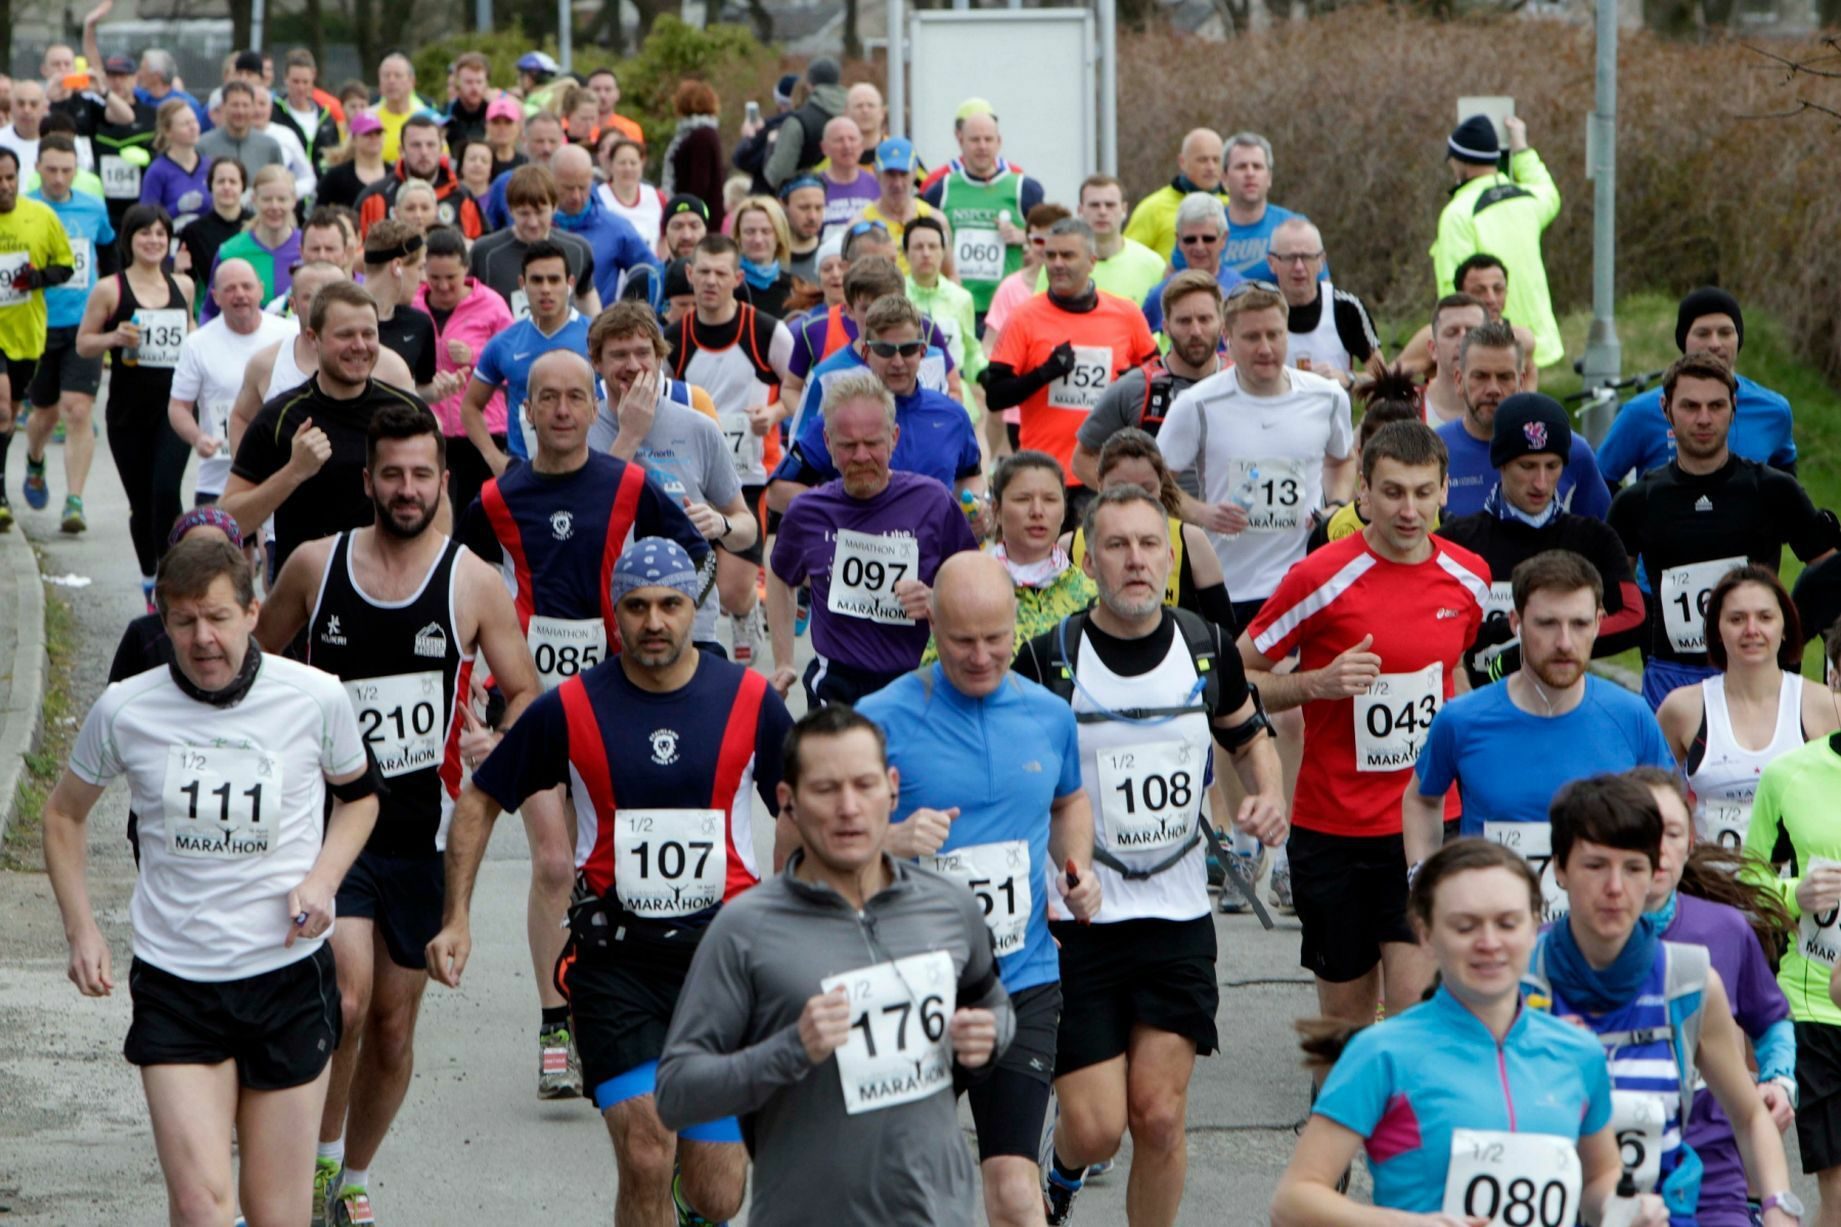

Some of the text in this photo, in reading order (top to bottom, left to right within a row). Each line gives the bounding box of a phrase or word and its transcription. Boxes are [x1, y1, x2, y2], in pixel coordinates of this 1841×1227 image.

[960, 243, 1000, 263] 060
[1225, 238, 1269, 260] RUN
[140, 326, 182, 347] 135
[1261, 478, 1299, 507] 13
[1247, 517, 1297, 529] ARATHON
[845, 539, 896, 555] MARATHON
[842, 556, 908, 593] 097
[1671, 573, 1690, 586] 1/2
[536, 625, 589, 639] MARATHON
[535, 643, 599, 677] 085
[355, 685, 379, 701] 1/2
[1367, 681, 1390, 696] 1/2
[358, 701, 435, 743] 210
[1366, 694, 1437, 739] 043
[180, 751, 207, 771] 1/2
[378, 747, 436, 772] ARATHON
[1111, 753, 1135, 770] 1/2
[180, 779, 263, 823] 111
[1115, 770, 1192, 815] 108
[1719, 807, 1741, 821] 1/2
[629, 817, 654, 833] 1/2
[175, 833, 268, 854] MARATHON
[1497, 829, 1521, 847] 1/2
[631, 840, 714, 880] 107
[934, 856, 959, 872] 1/2
[627, 896, 714, 912] MARATHON
[968, 875, 1015, 916] 51
[850, 995, 945, 1058] 176
[1471, 1142, 1506, 1163] 1/2
[1464, 1173, 1567, 1227] 080
